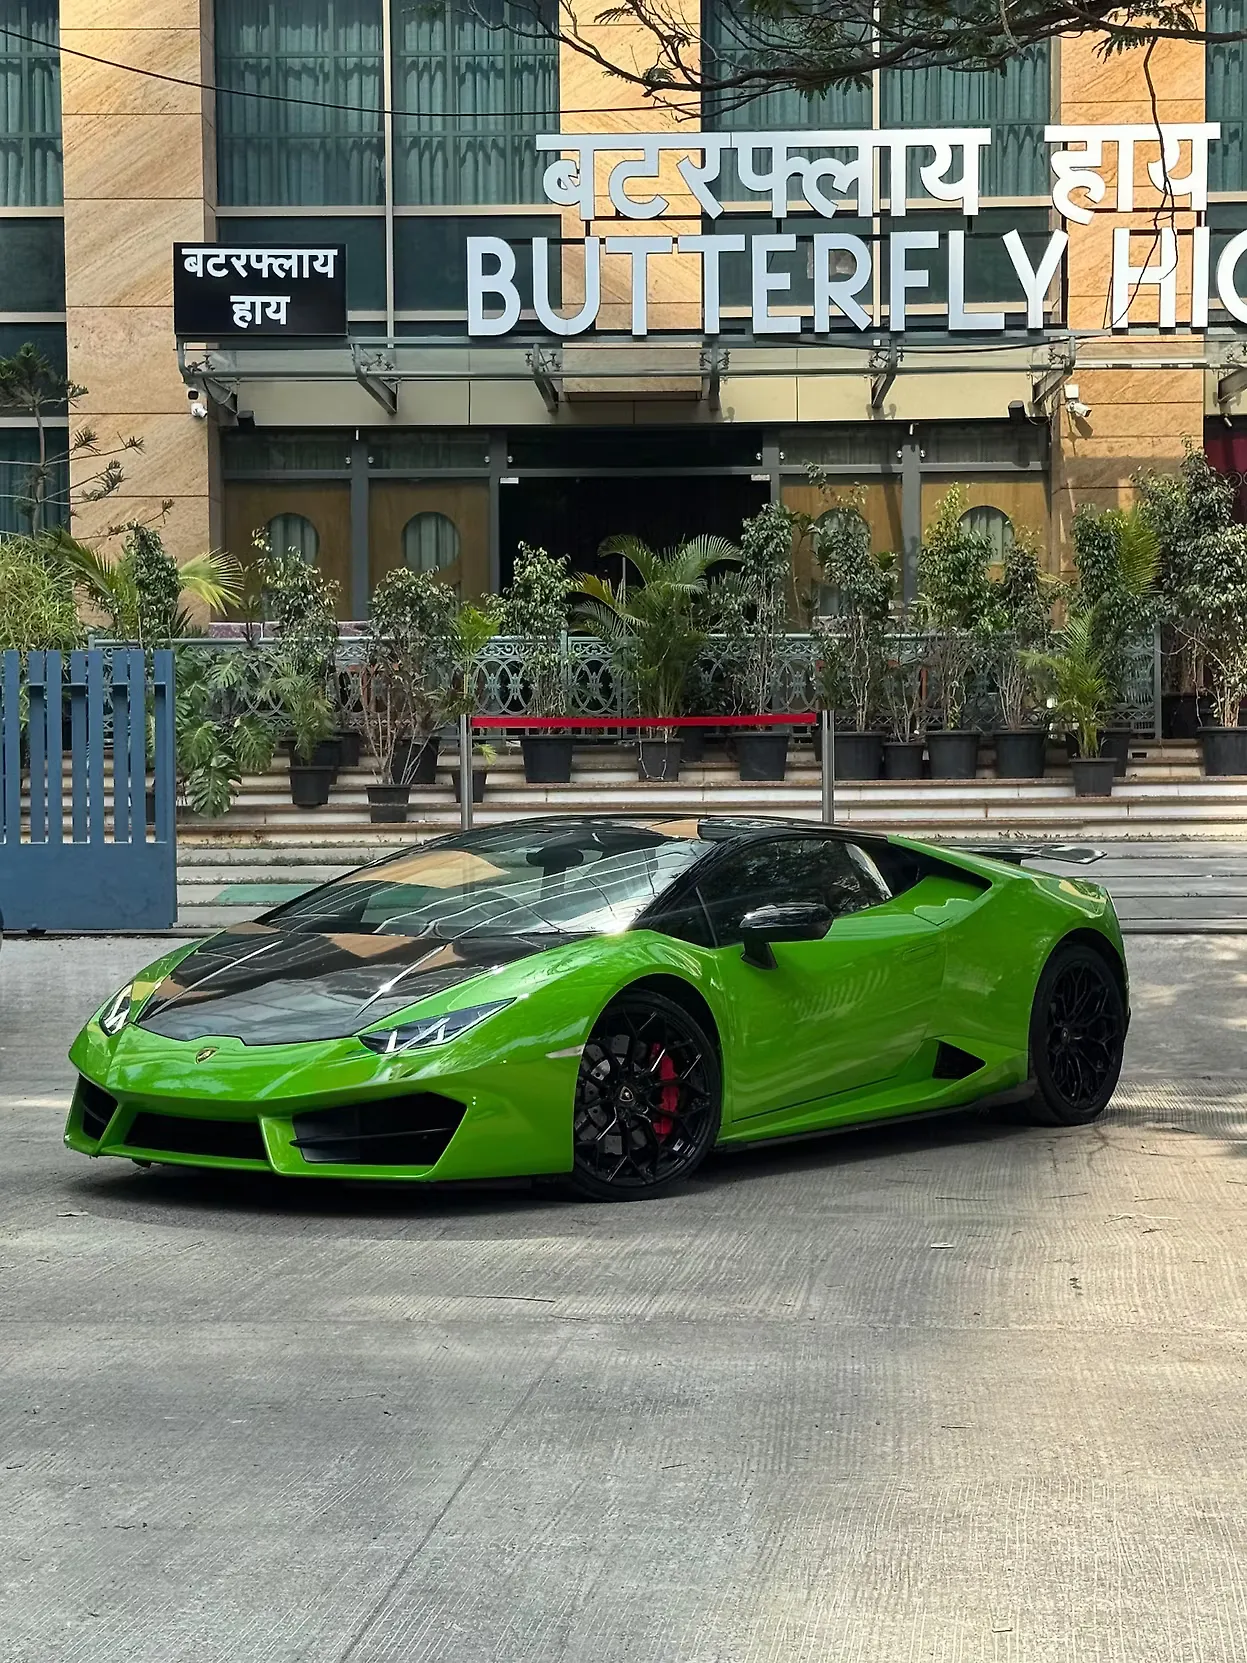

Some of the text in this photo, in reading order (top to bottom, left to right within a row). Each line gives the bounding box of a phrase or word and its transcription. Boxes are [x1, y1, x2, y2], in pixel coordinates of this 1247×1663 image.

[535, 122, 1221, 225] बटरफ्लाय हाय
[181, 248, 338, 279] बटरफ्लाय
[466, 227, 1070, 336] BUTTERFLY
[229, 295, 291, 329] हाय
